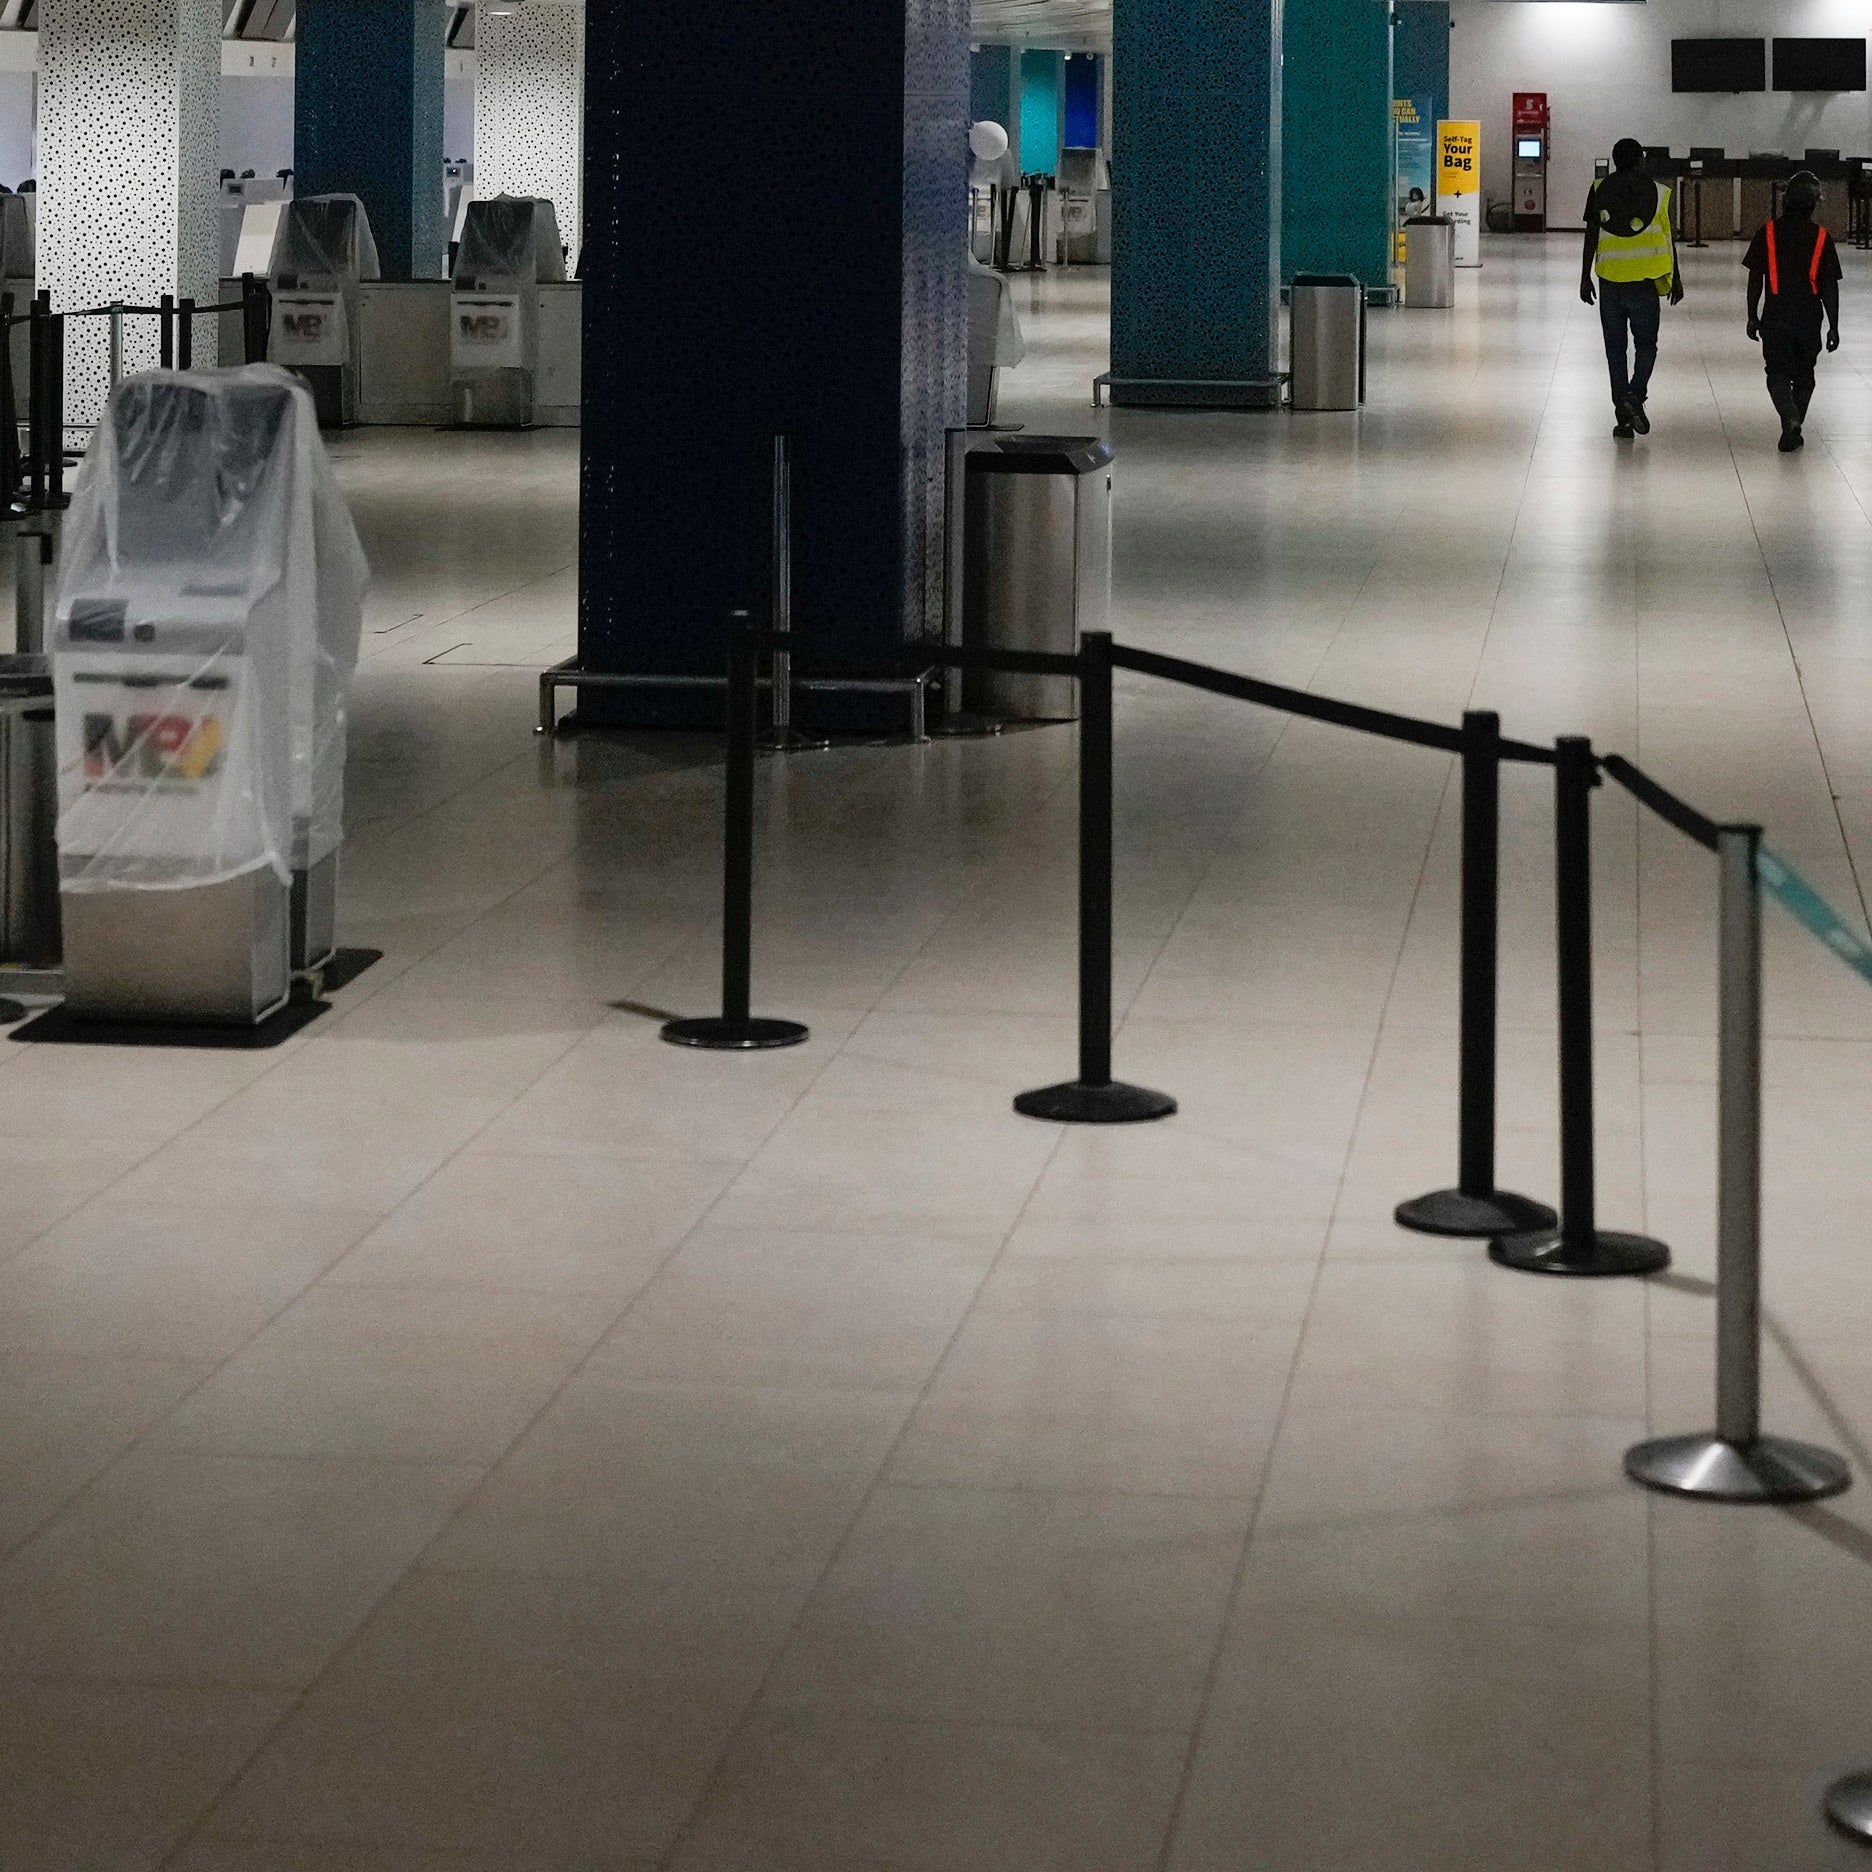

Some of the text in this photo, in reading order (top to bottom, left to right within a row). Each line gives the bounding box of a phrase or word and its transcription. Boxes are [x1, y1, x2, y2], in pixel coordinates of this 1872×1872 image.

[1443, 135, 1473, 144] Self-Tag
[1443, 144, 1472, 154] Your
[1443, 155, 1472, 171] Bag
